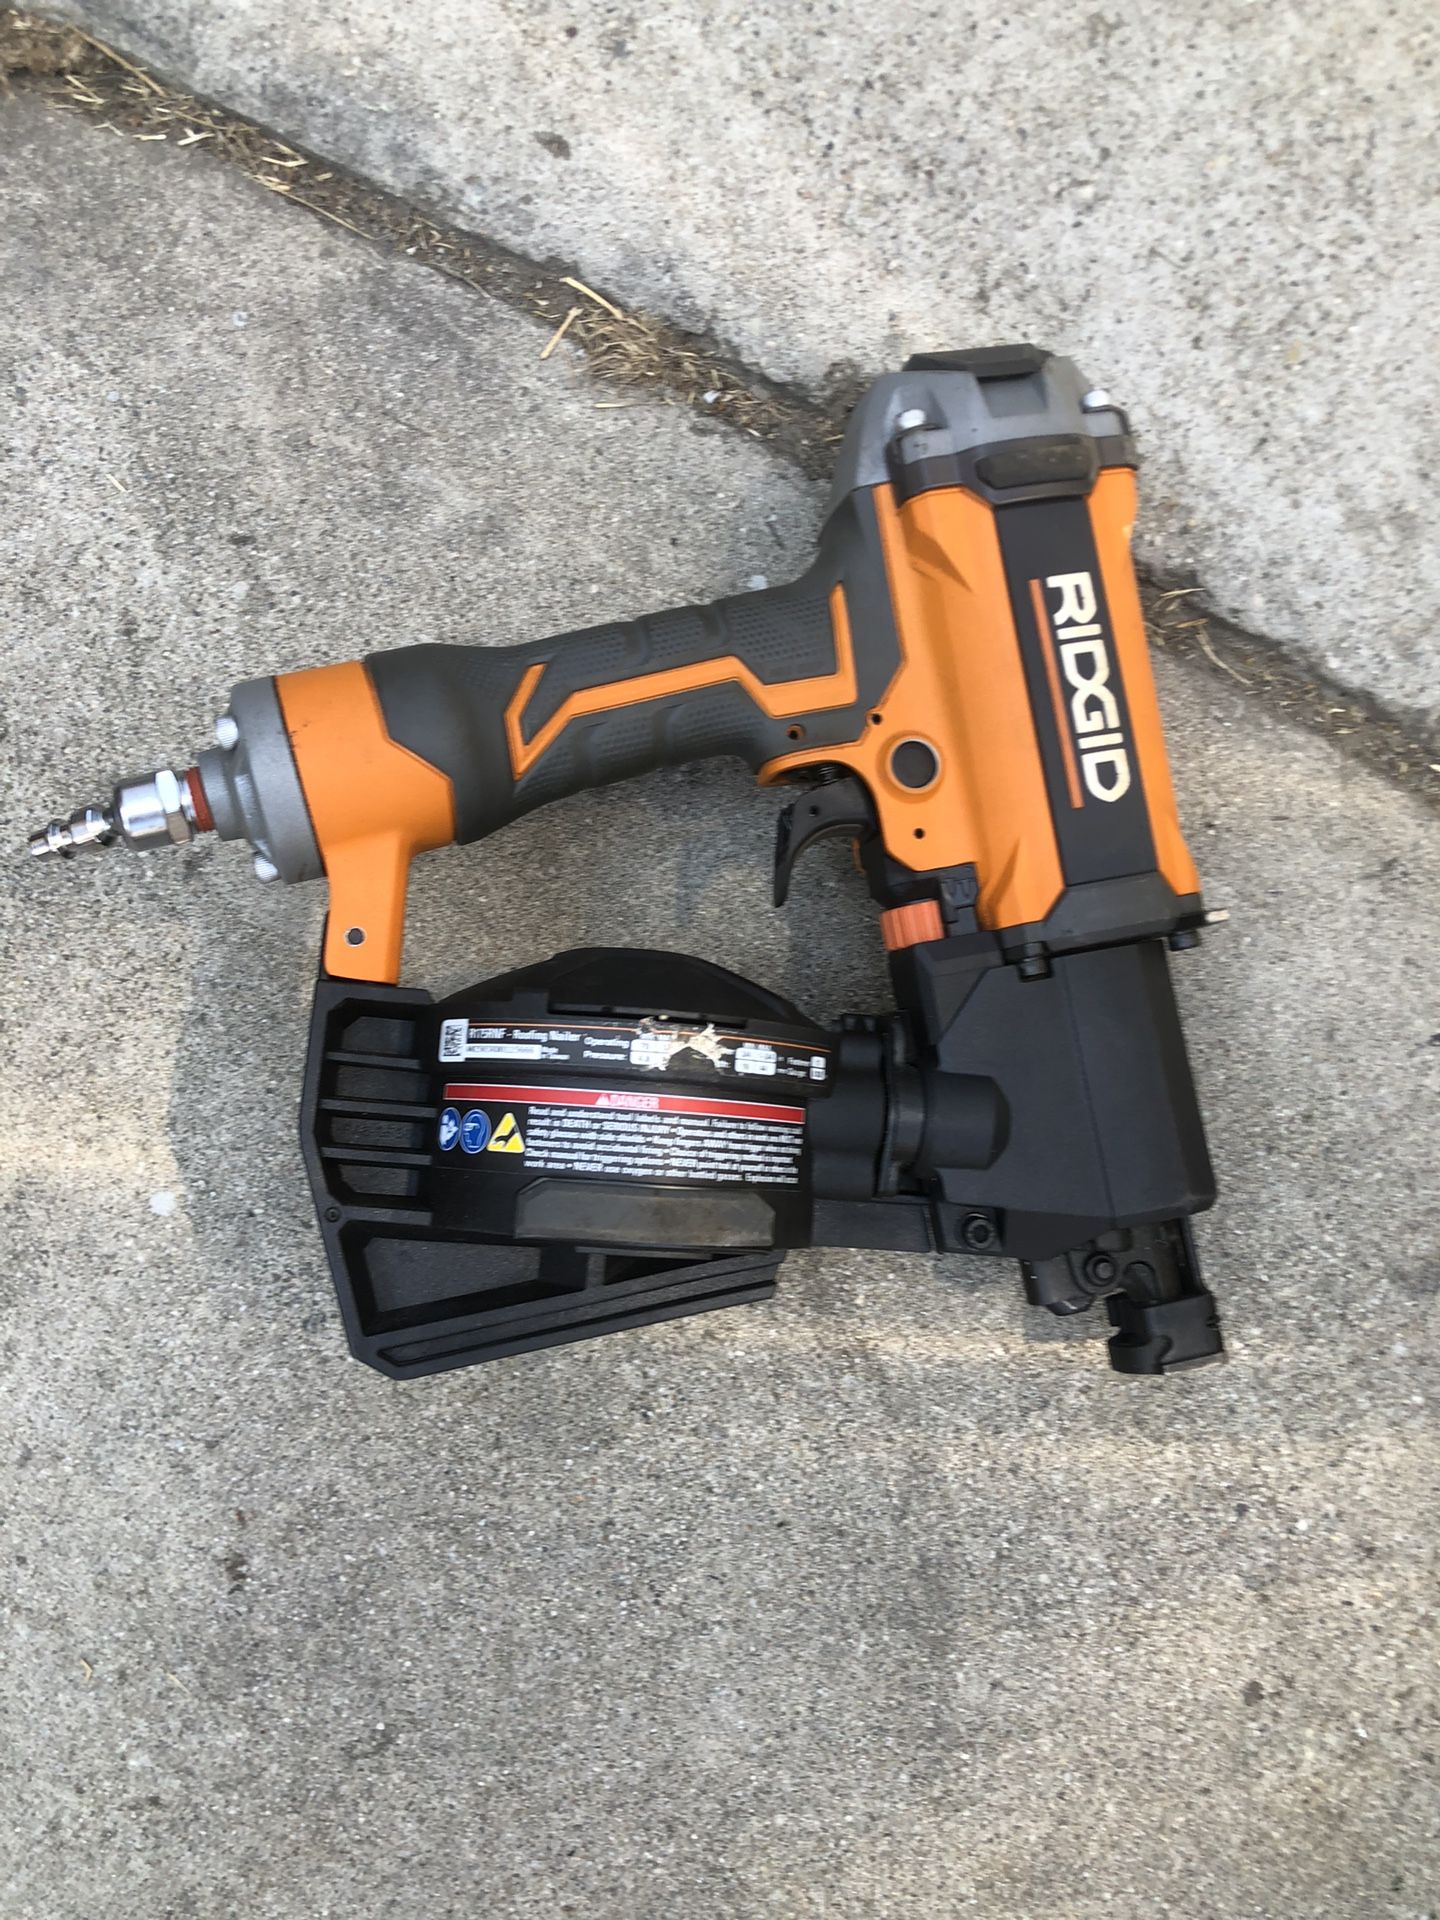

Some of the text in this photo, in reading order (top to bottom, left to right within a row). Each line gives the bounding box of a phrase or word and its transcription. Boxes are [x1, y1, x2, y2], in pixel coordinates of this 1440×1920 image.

[1046, 571, 1131, 802] RIDGID
[512, 1029, 548, 1043] Roofing
[609, 1094, 659, 1109] DANGER
